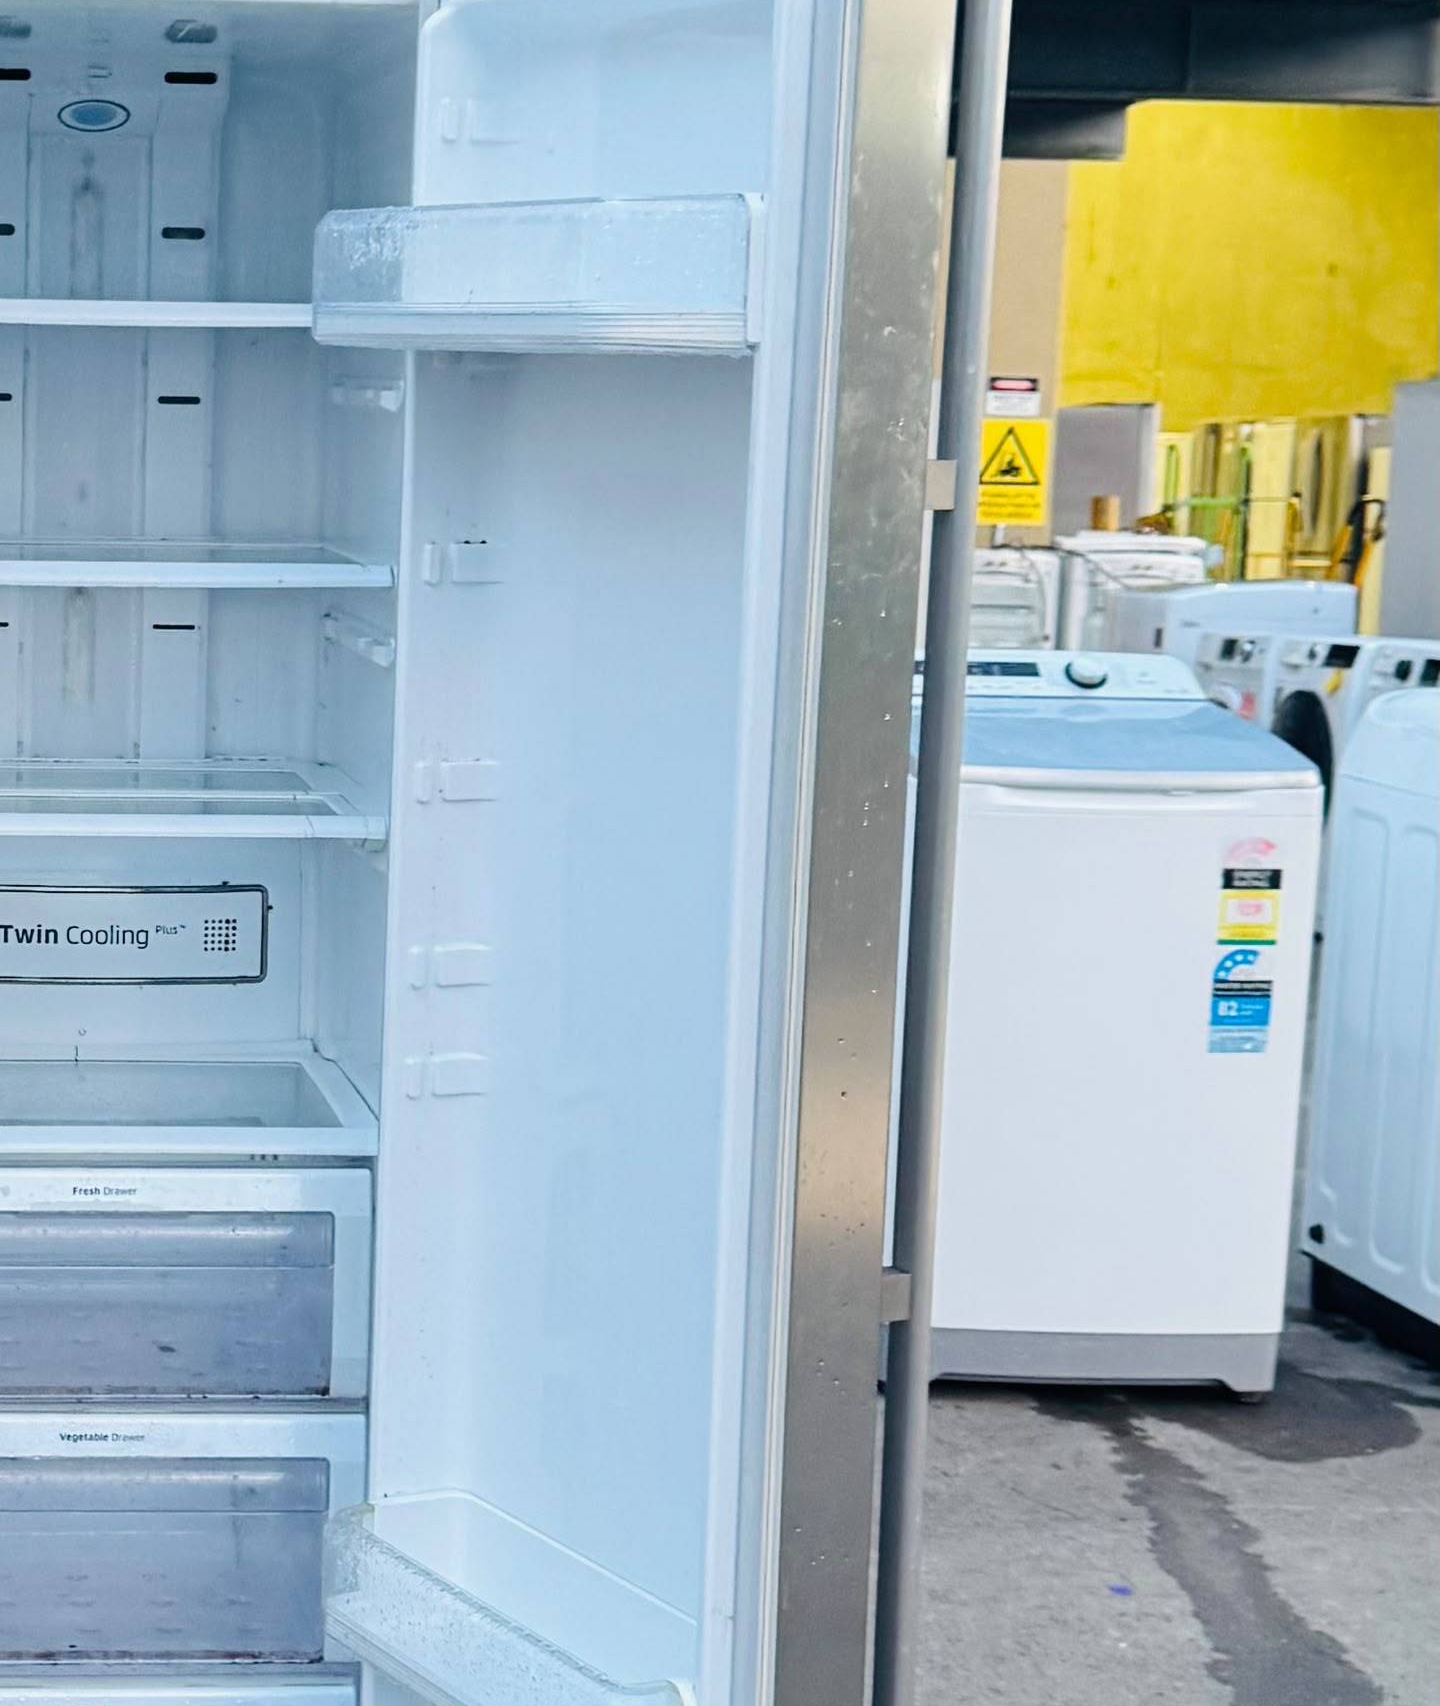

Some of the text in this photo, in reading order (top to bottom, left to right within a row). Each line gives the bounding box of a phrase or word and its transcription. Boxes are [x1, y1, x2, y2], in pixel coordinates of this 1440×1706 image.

[66, 924, 150, 950] Cooling
[72, 1186, 137, 1196] Fresh Drawer
[59, 1432, 146, 1443] Vegetable Drawer
